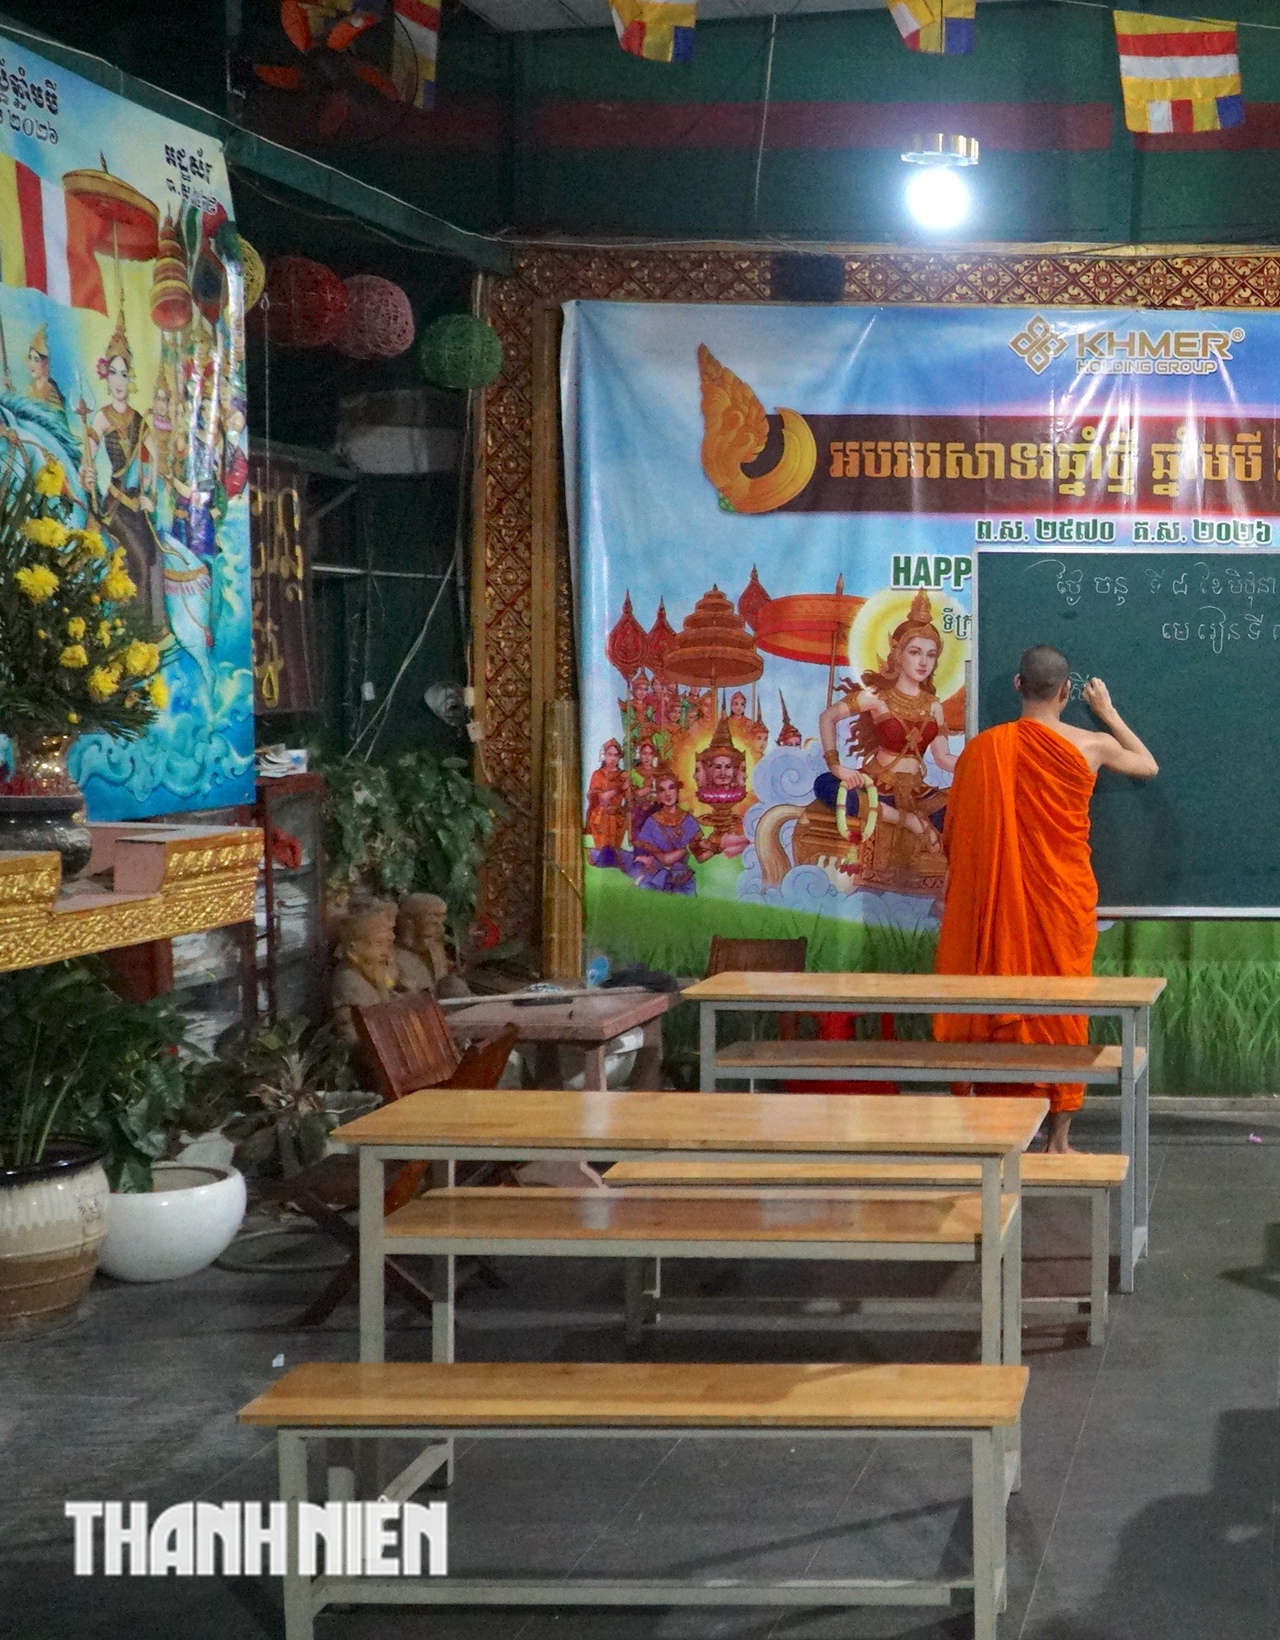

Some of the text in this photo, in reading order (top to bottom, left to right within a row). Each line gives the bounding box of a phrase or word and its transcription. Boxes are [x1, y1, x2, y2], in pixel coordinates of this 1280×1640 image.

[1077, 360, 1217, 375] HOLDING GROUP
[1193, 520, 1271, 544] ២០២៦
[892, 556, 972, 588] HAPP
